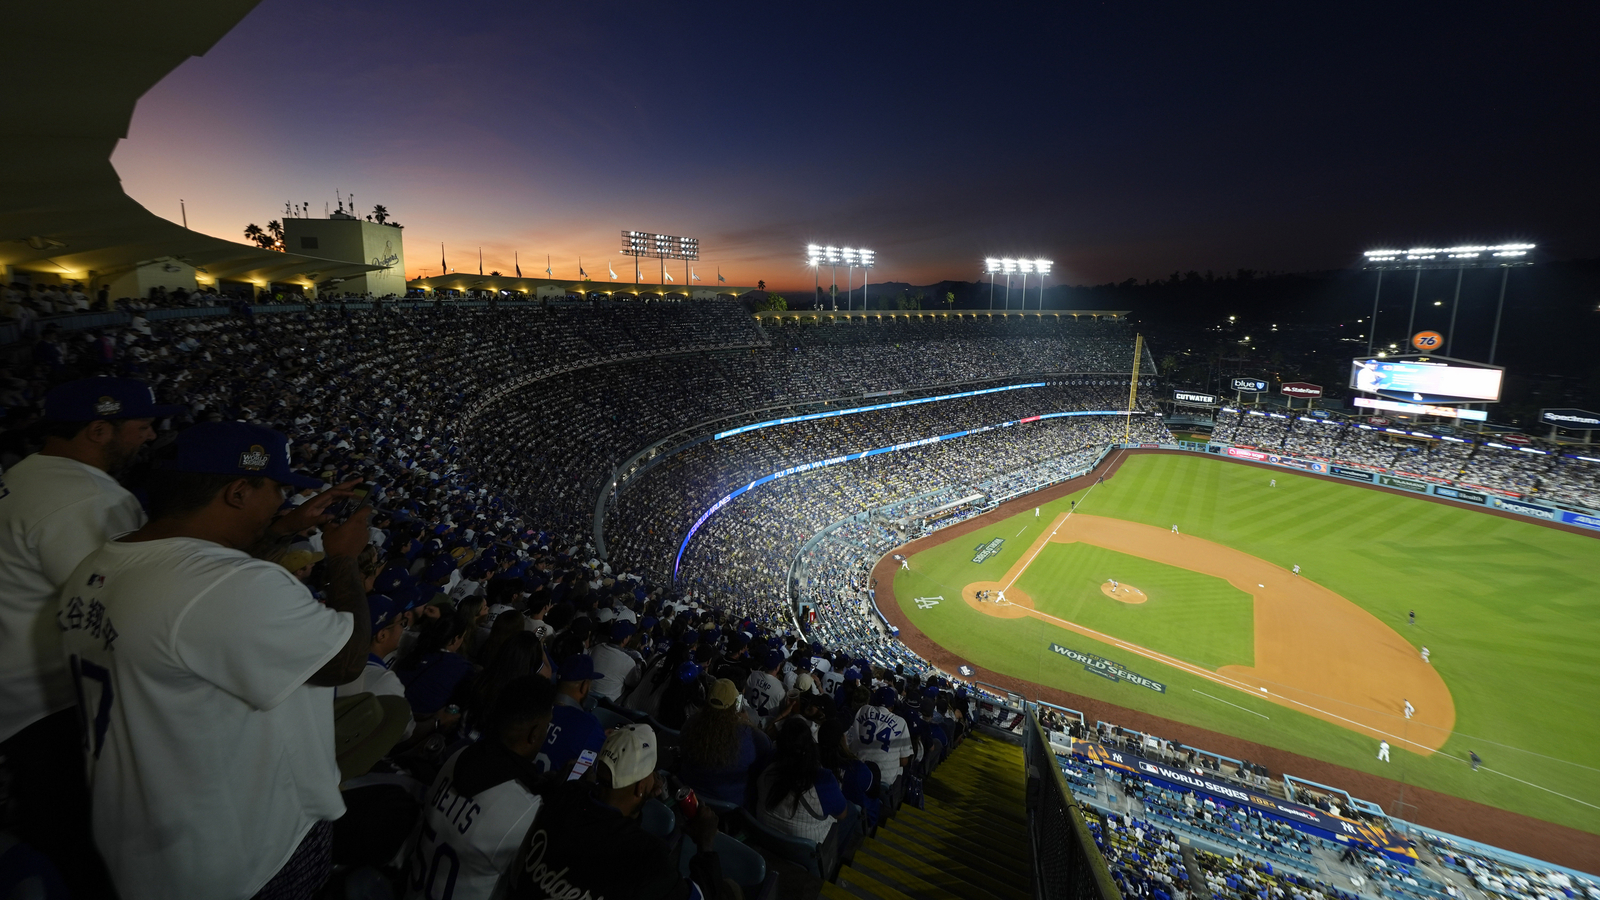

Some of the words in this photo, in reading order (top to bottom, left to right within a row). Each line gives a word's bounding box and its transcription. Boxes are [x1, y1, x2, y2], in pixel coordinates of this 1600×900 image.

[1417, 335, 1438, 347] 76
[1234, 379, 1256, 389] blue
[1176, 393, 1213, 403] CUTWATER
[1543, 412, 1599, 425] Spectrum
[774, 471, 785, 479] FLY
[824, 456, 847, 466] TAIWAN
[1458, 492, 1485, 503] Health
[1501, 502, 1554, 520] MORTON
[1053, 644, 1106, 670] WORLD
[1106, 666, 1163, 693] SERIES
[755, 678, 772, 691] KEMP
[751, 687, 770, 709] 27
[856, 711, 903, 738] VALENZUELA
[859, 721, 892, 753] 34
[1158, 767, 1205, 788] WORLD
[1204, 782, 1250, 802] SERIES
[431, 776, 481, 835] BETTS
